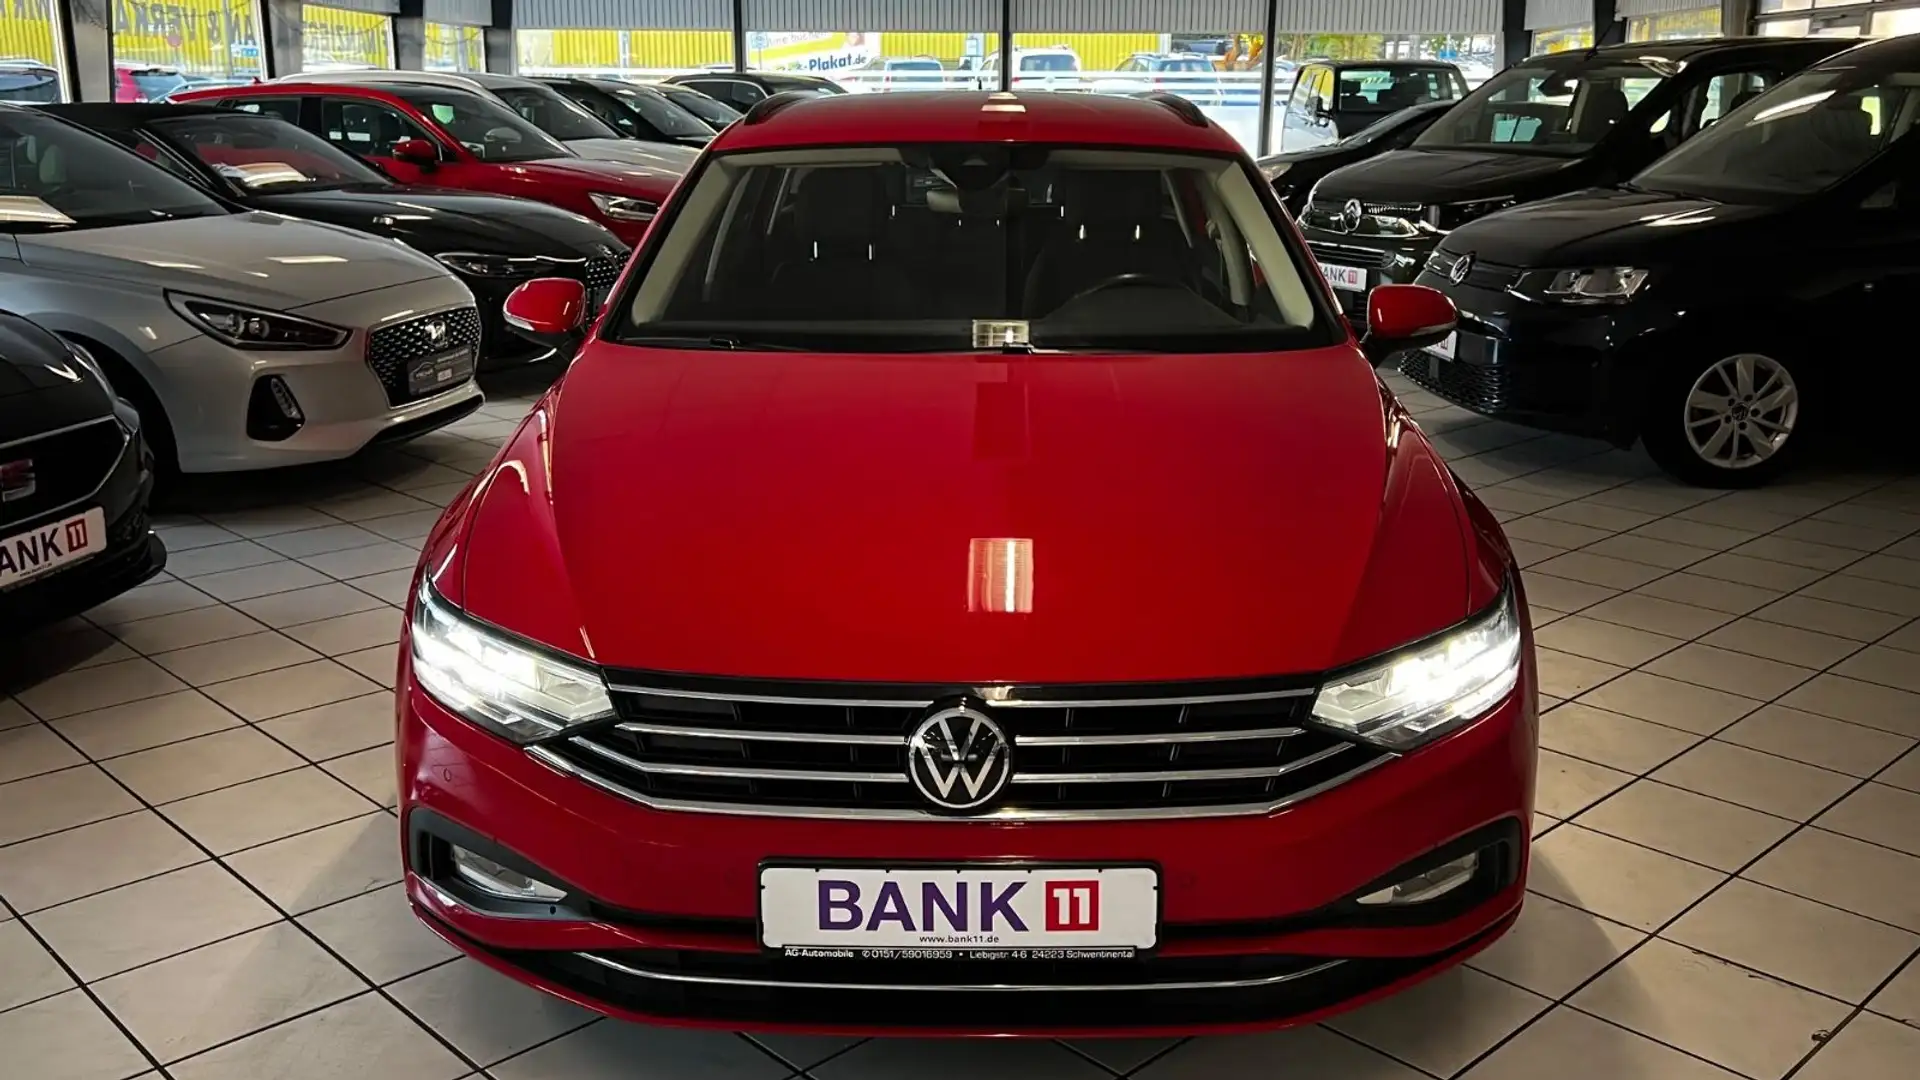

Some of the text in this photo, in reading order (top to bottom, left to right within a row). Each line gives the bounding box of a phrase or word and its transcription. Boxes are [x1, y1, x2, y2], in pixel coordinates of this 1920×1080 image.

[1320, 266, 1346, 283] ANK
[67, 521, 87, 550] 11
[818, 880, 1094, 932] BANK 11
[919, 935, 999, 943] www.bank11.de
[1032, 950, 1064, 959] 24223
